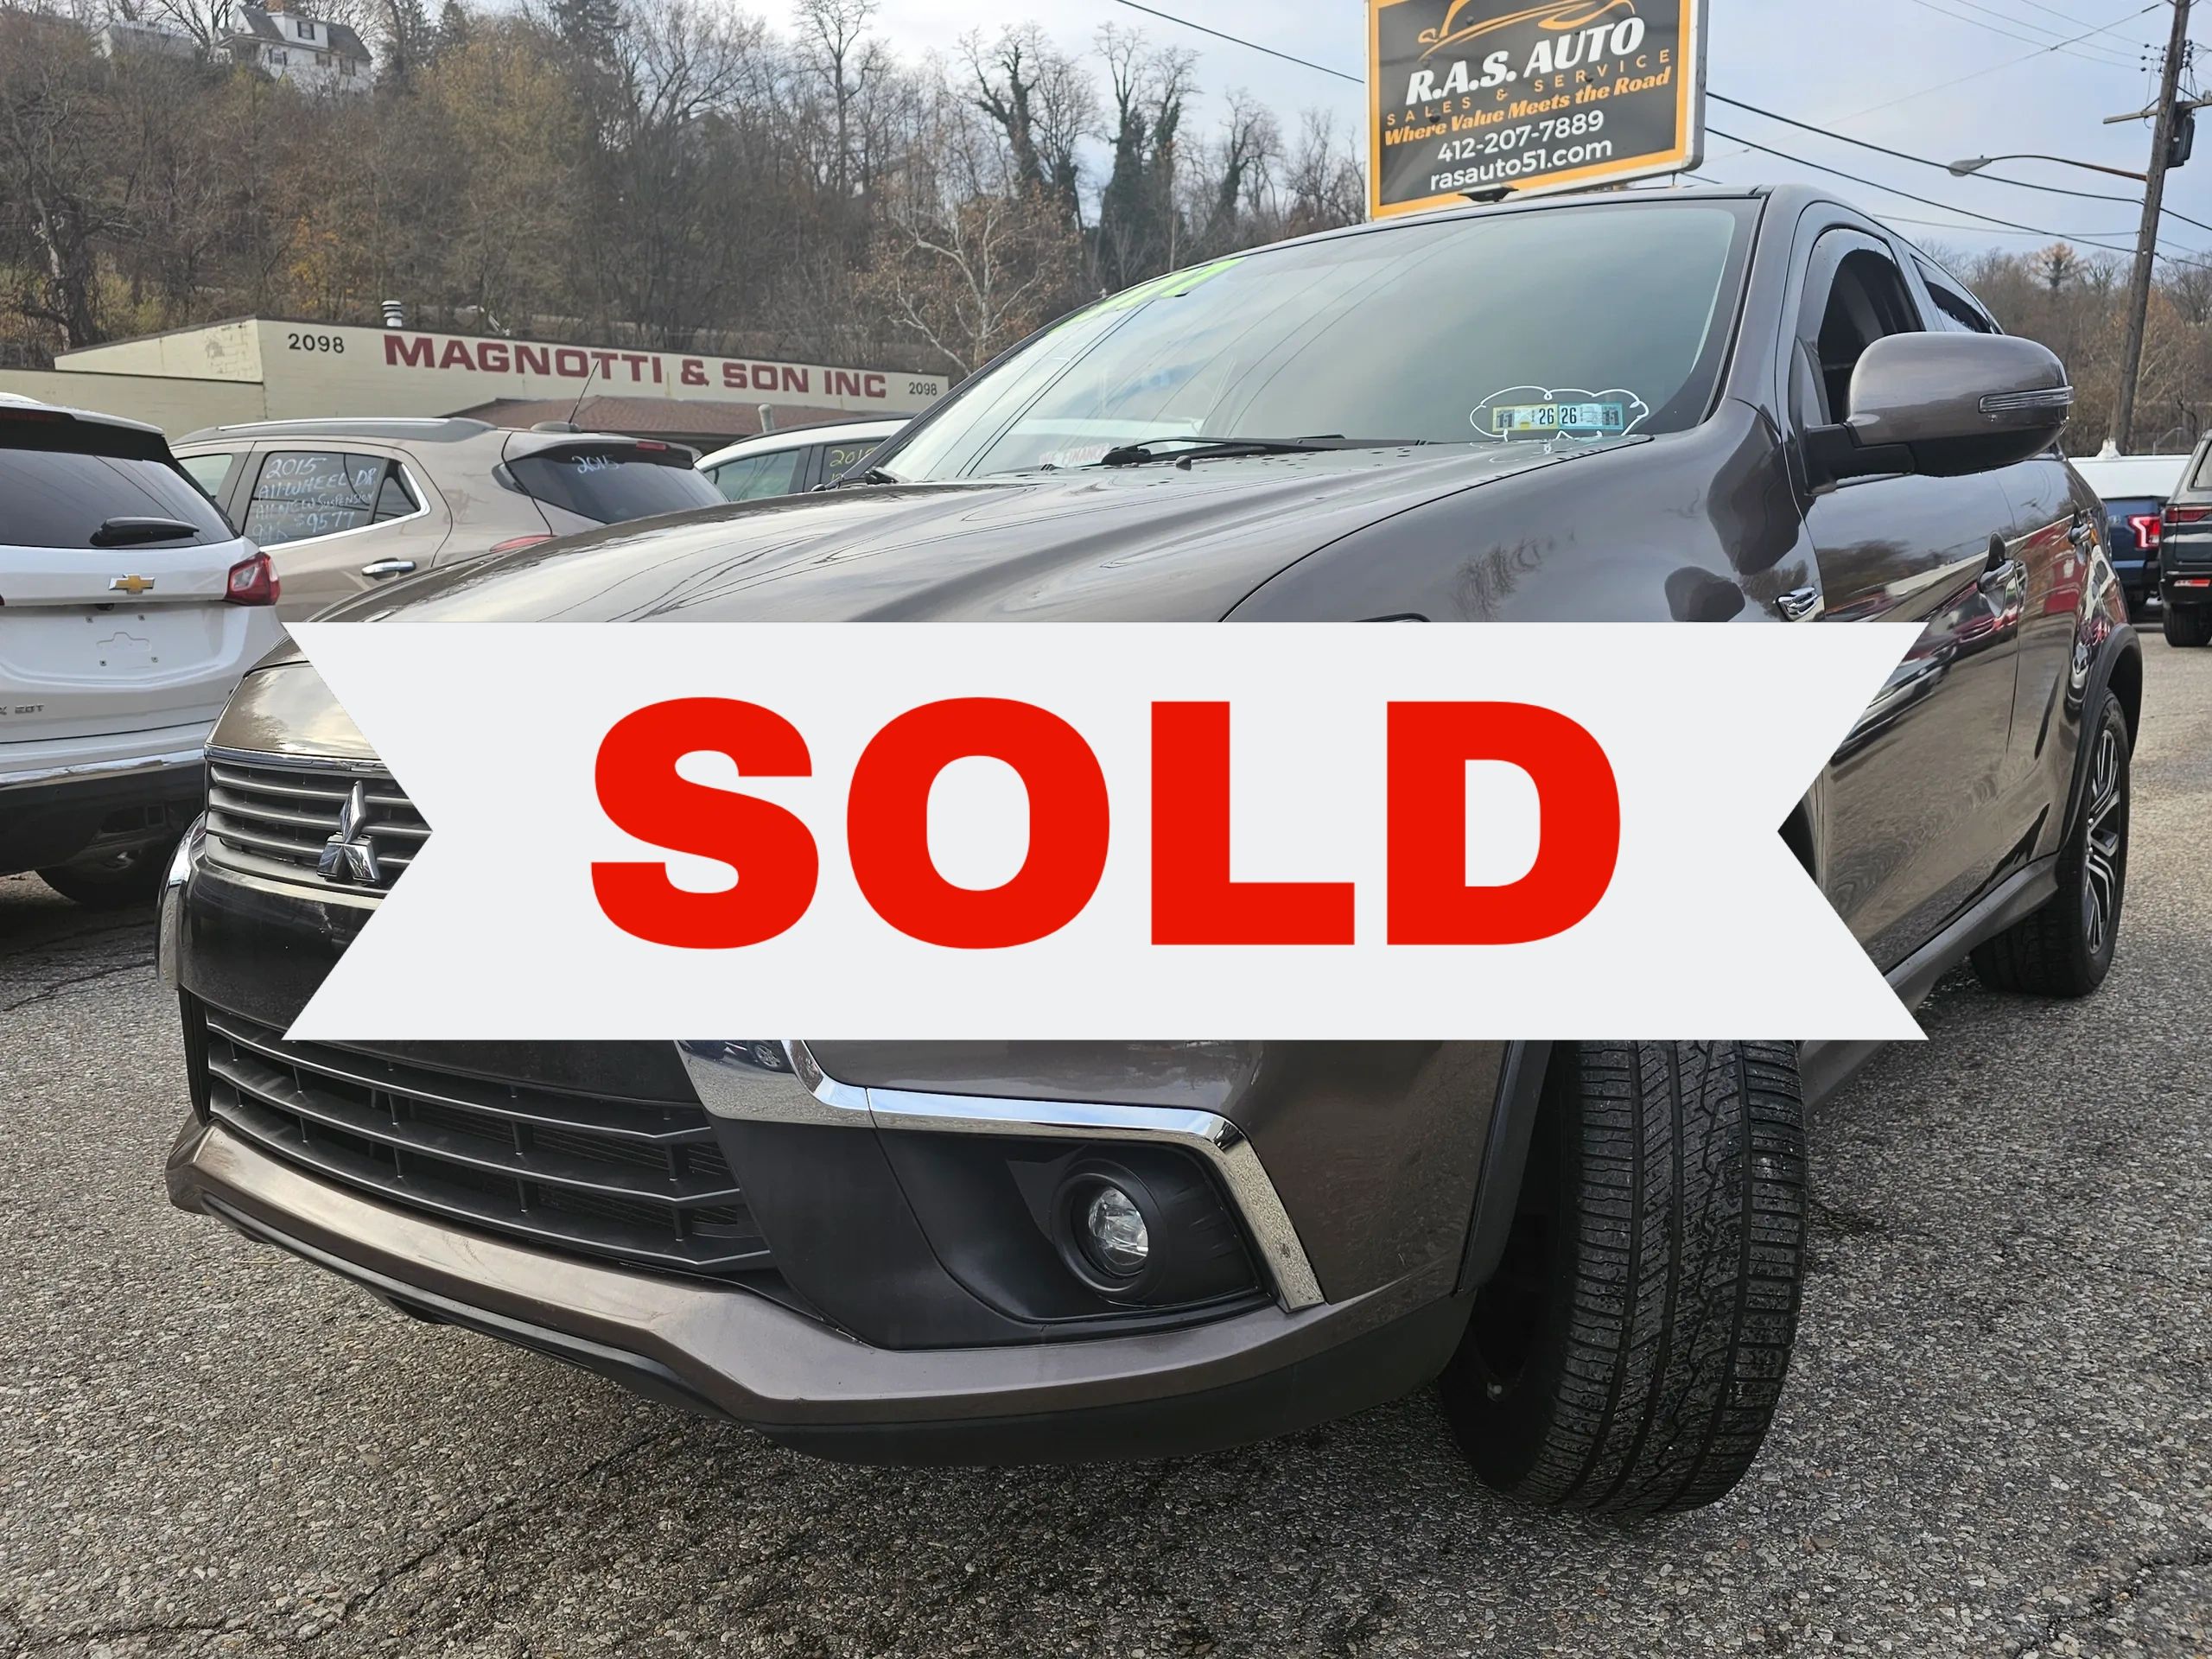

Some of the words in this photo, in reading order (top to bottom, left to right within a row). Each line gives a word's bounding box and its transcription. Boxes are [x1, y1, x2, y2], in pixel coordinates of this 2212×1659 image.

[1387, 98, 1471, 125] SALES
[1497, 87, 1508, 100] &
[1535, 49, 1670, 92] SERVICE
[1406, 49, 1516, 105] R.A.S.
[1523, 16, 1645, 78] AUTO
[1384, 120, 1446, 146] Where
[1451, 109, 1504, 133] Value
[1508, 94, 1570, 119] Meets
[1575, 84, 1610, 105] the
[1613, 67, 1671, 96] Road
[1437, 110, 1605, 163] 412-207-7889
[1430, 139, 1612, 192] rasauto51.com
[288, 334, 345, 354] 2098
[384, 334, 662, 383] MAGNOTTI
[681, 359, 709, 387] &
[722, 361, 809, 393] SON
[824, 370, 886, 398] INC
[908, 381, 938, 397] 2098
[1561, 407, 1577, 423] 26
[1539, 408, 1554, 424] 26
[267, 457, 327, 480] 2015
